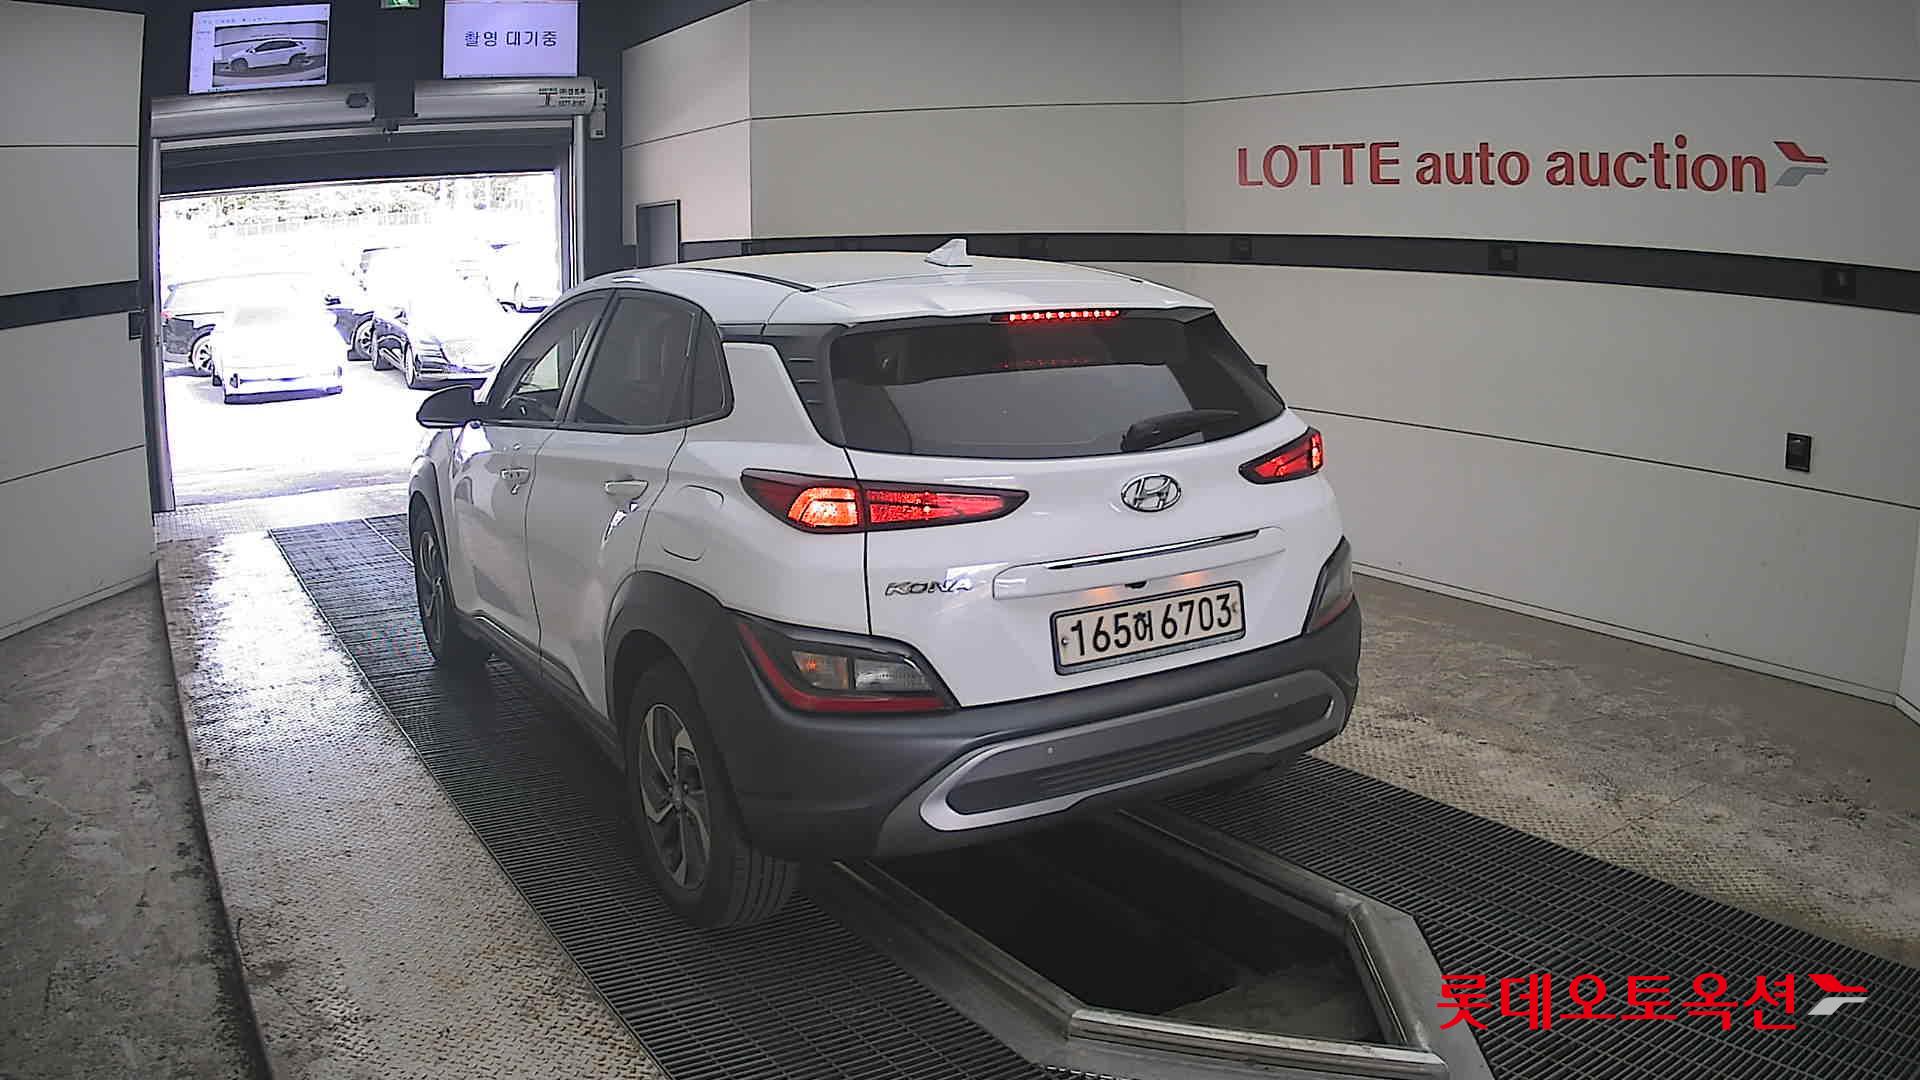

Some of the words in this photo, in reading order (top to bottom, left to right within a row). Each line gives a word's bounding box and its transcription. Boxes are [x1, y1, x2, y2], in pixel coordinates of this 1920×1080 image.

[465, 31, 497, 47] 촬영
[506, 31, 557, 47] 대기중
[1237, 141, 1401, 188] LOTTE
[1415, 142, 1530, 186] auto
[1545, 134, 1767, 193] auction
[885, 580, 973, 596] KONA
